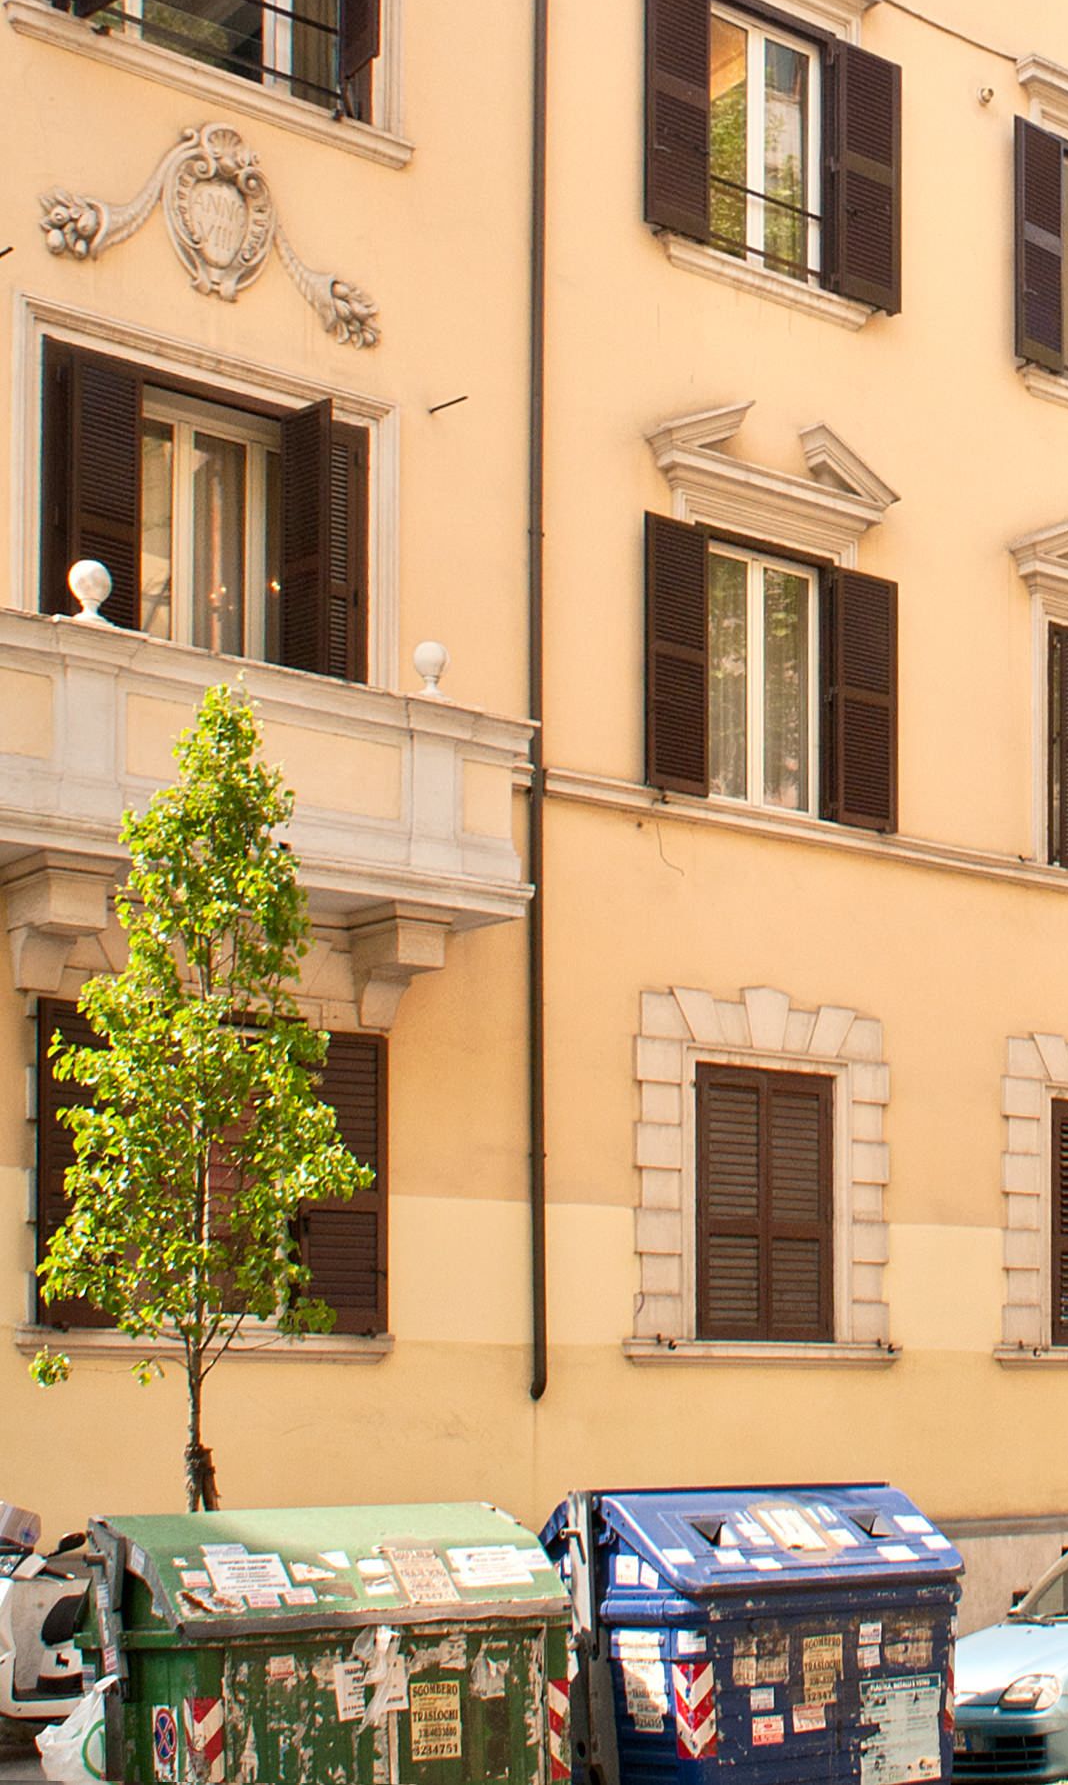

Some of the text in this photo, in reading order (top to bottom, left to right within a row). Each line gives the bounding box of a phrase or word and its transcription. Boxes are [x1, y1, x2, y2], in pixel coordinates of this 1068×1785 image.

[193, 191, 247, 228] ANNO
[412, 1682, 458, 1698] SGOMBERO
[412, 1709, 458, 1723] TRASLOCHI
